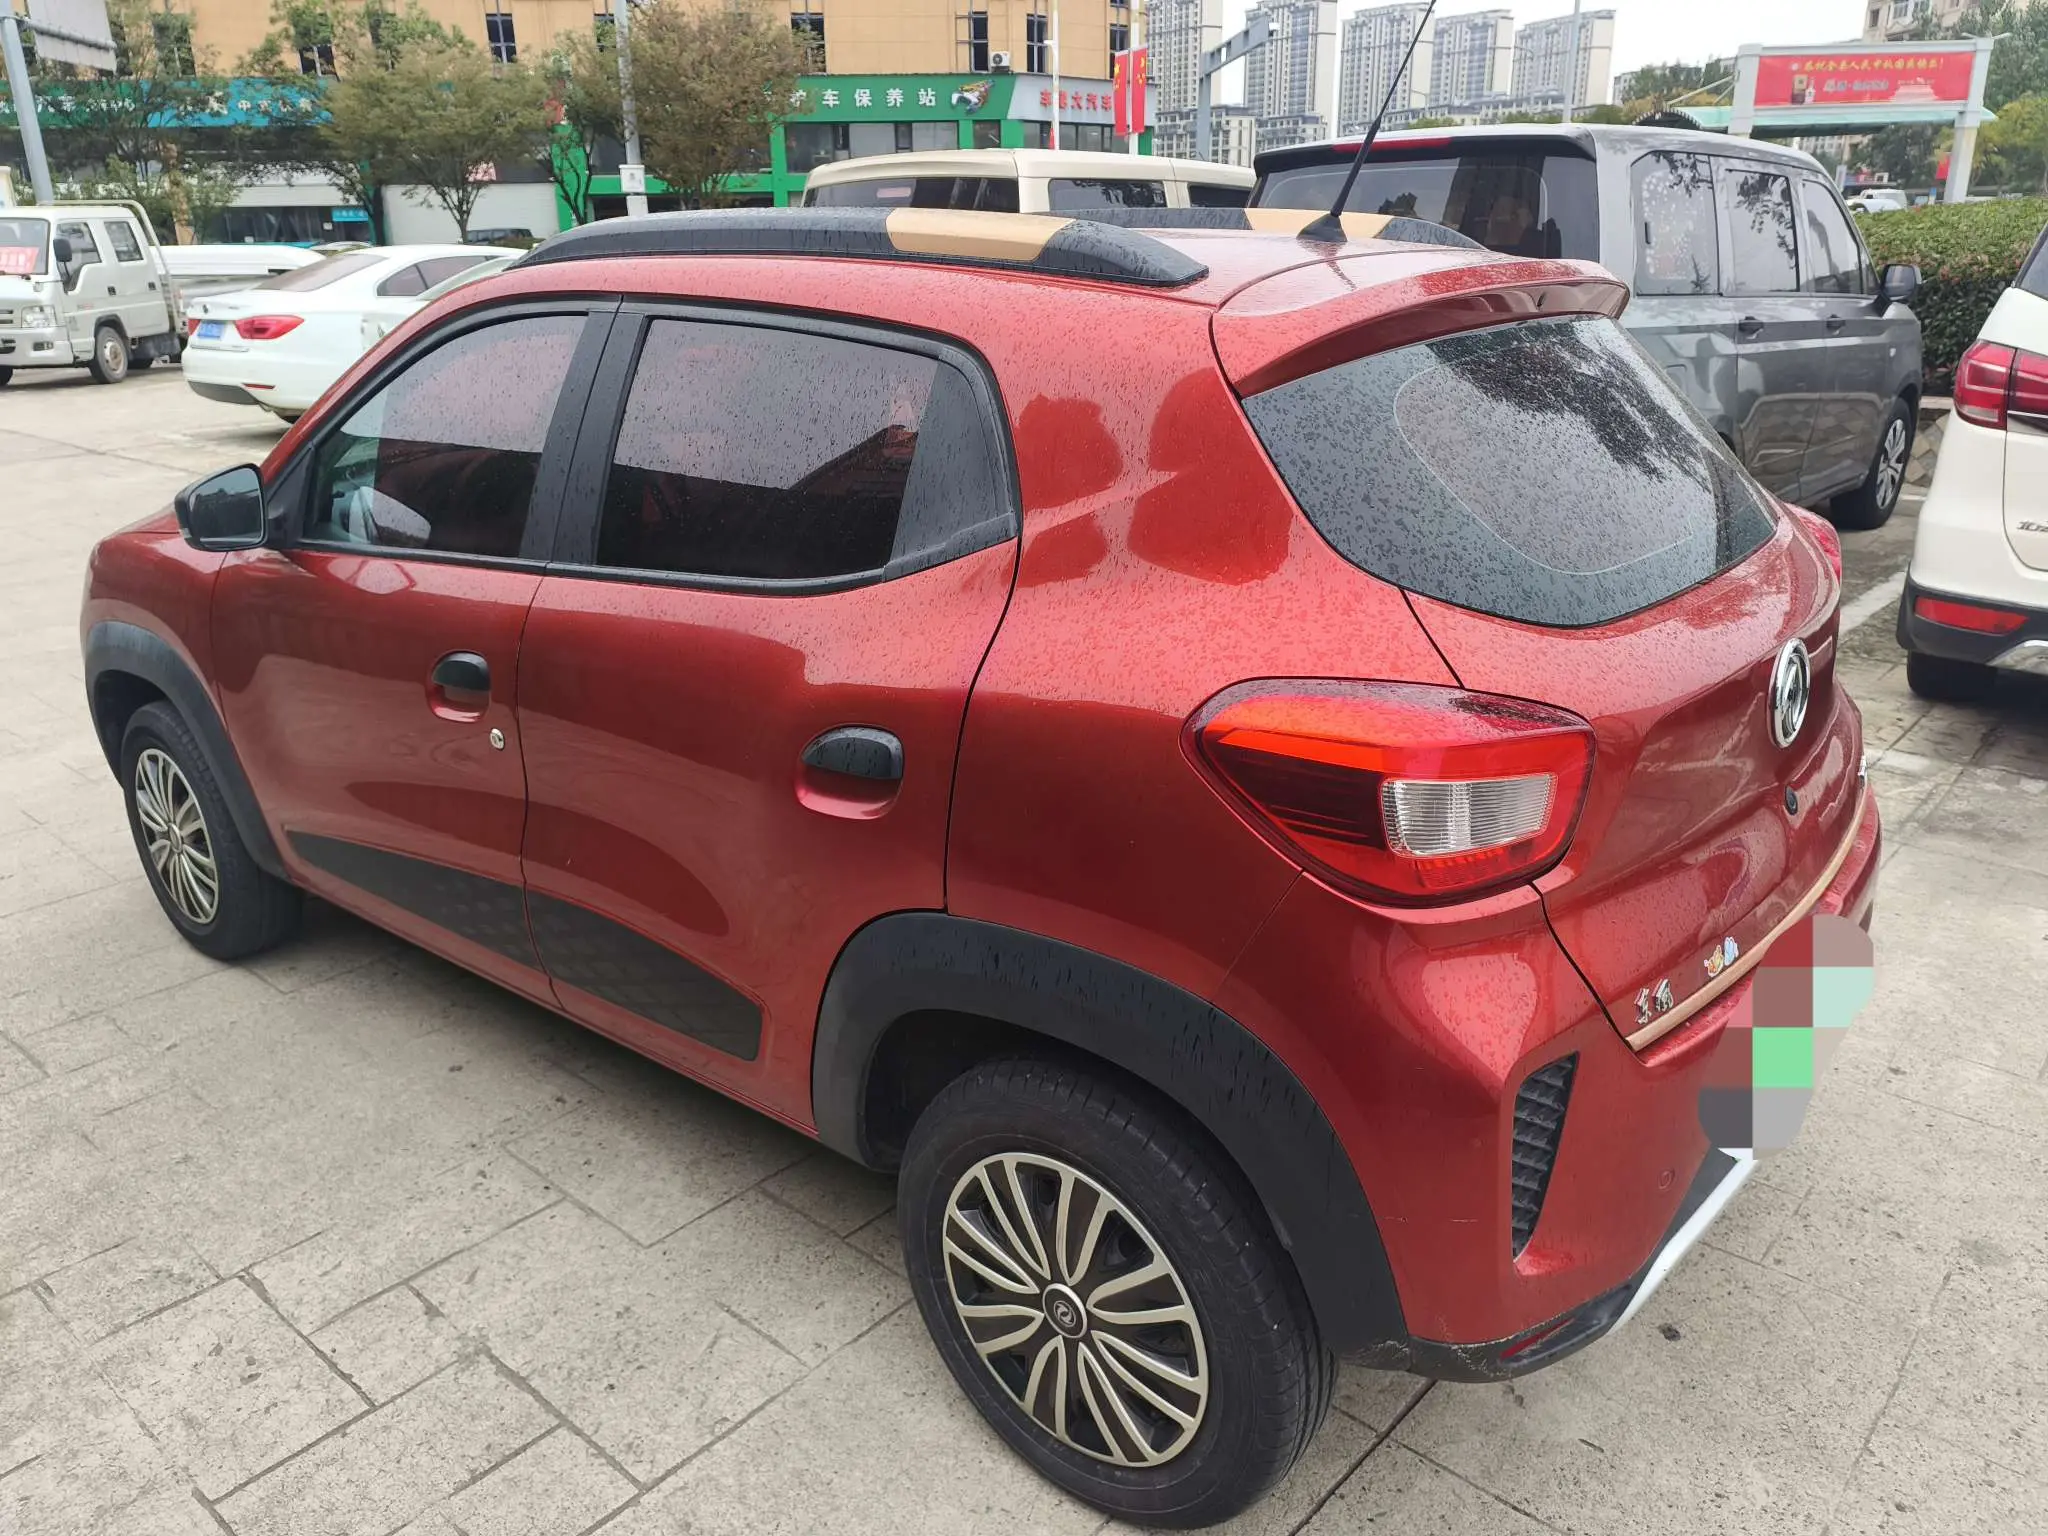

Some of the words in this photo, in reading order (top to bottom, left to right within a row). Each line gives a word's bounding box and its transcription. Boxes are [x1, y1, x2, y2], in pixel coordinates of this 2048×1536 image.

[763, 87, 937, 108] 护车保养站
